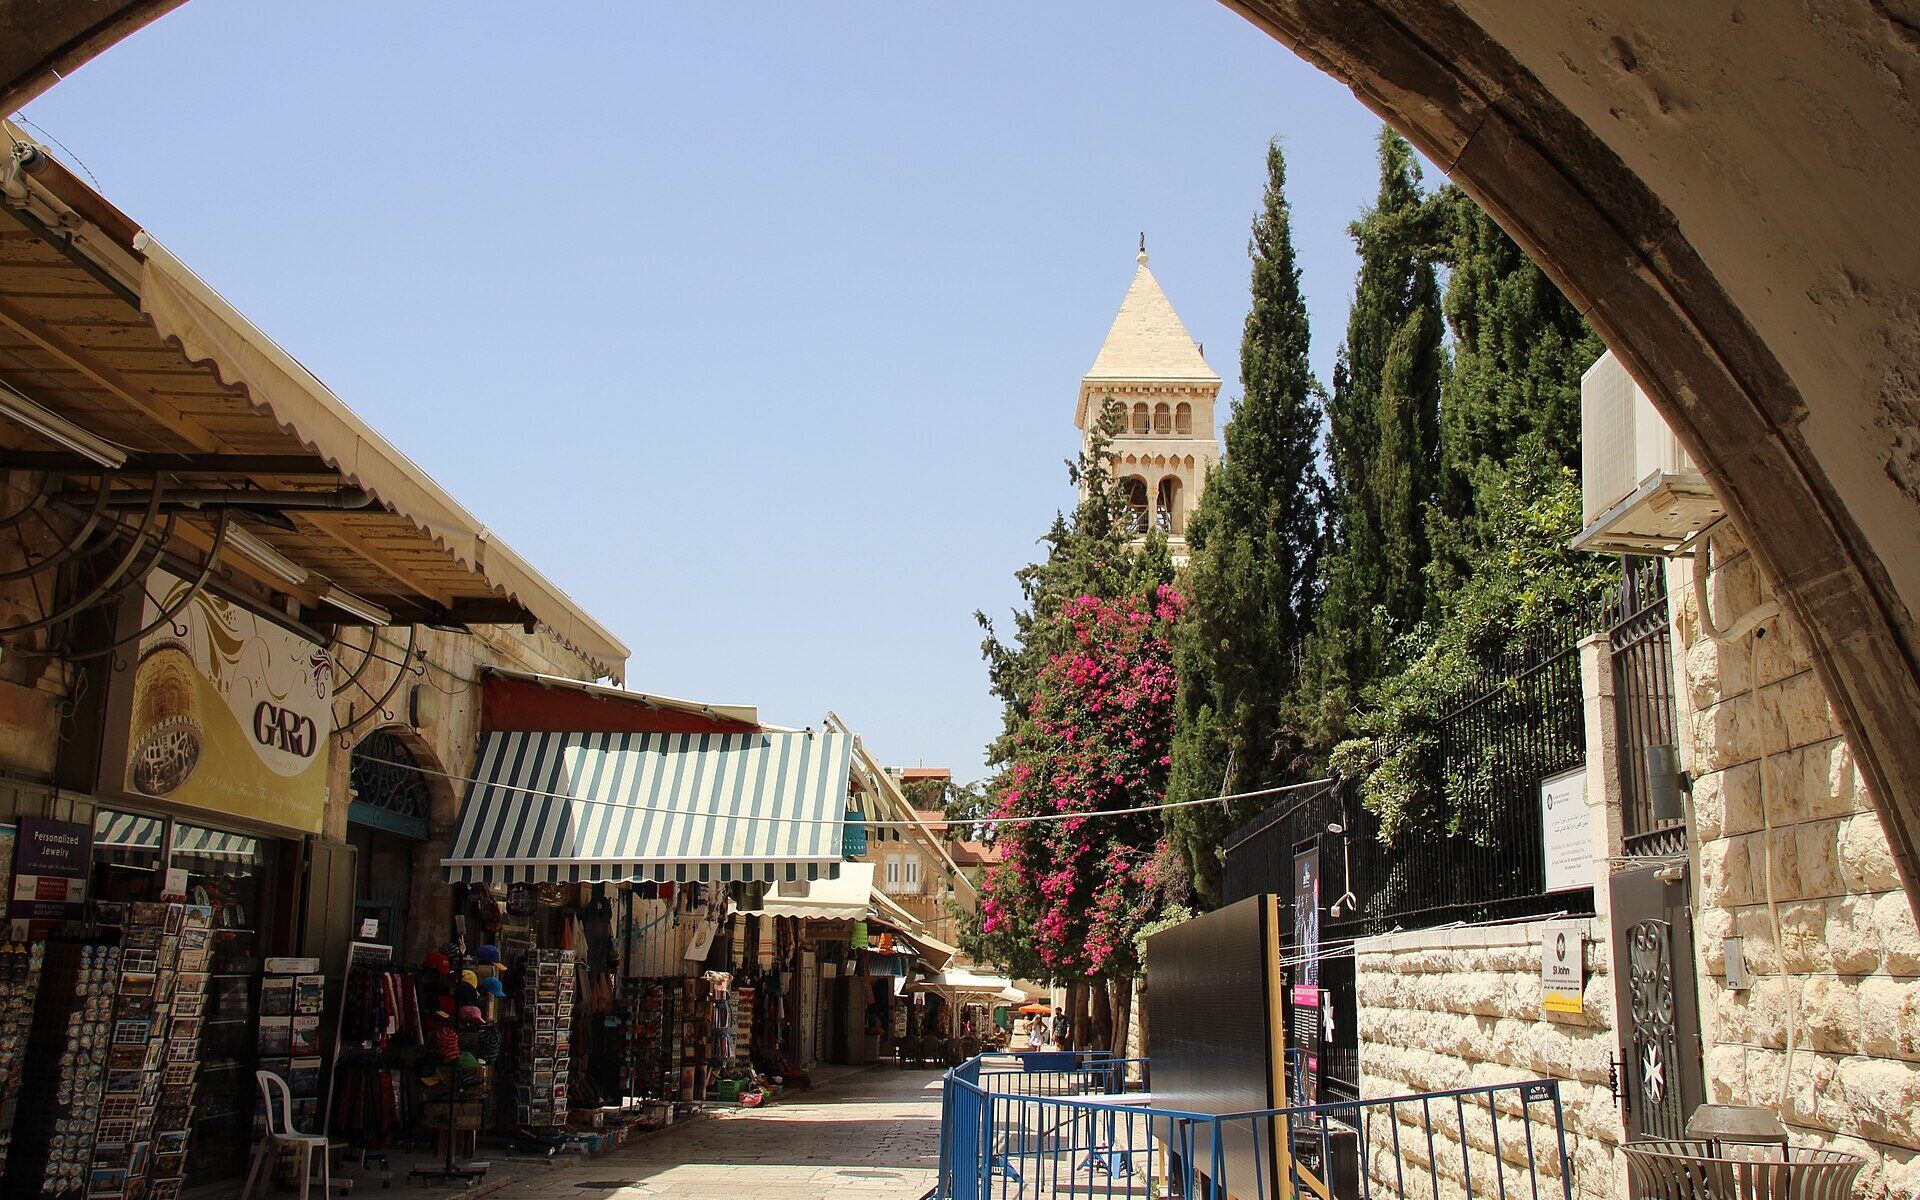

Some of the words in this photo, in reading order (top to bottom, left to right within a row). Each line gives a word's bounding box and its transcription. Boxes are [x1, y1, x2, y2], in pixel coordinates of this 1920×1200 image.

[34, 831, 79, 845] Personalized
[41, 847, 69, 859] Jewelry
[1558, 965, 1570, 976] John
[296, 1018, 317, 1026] ISRAEL
